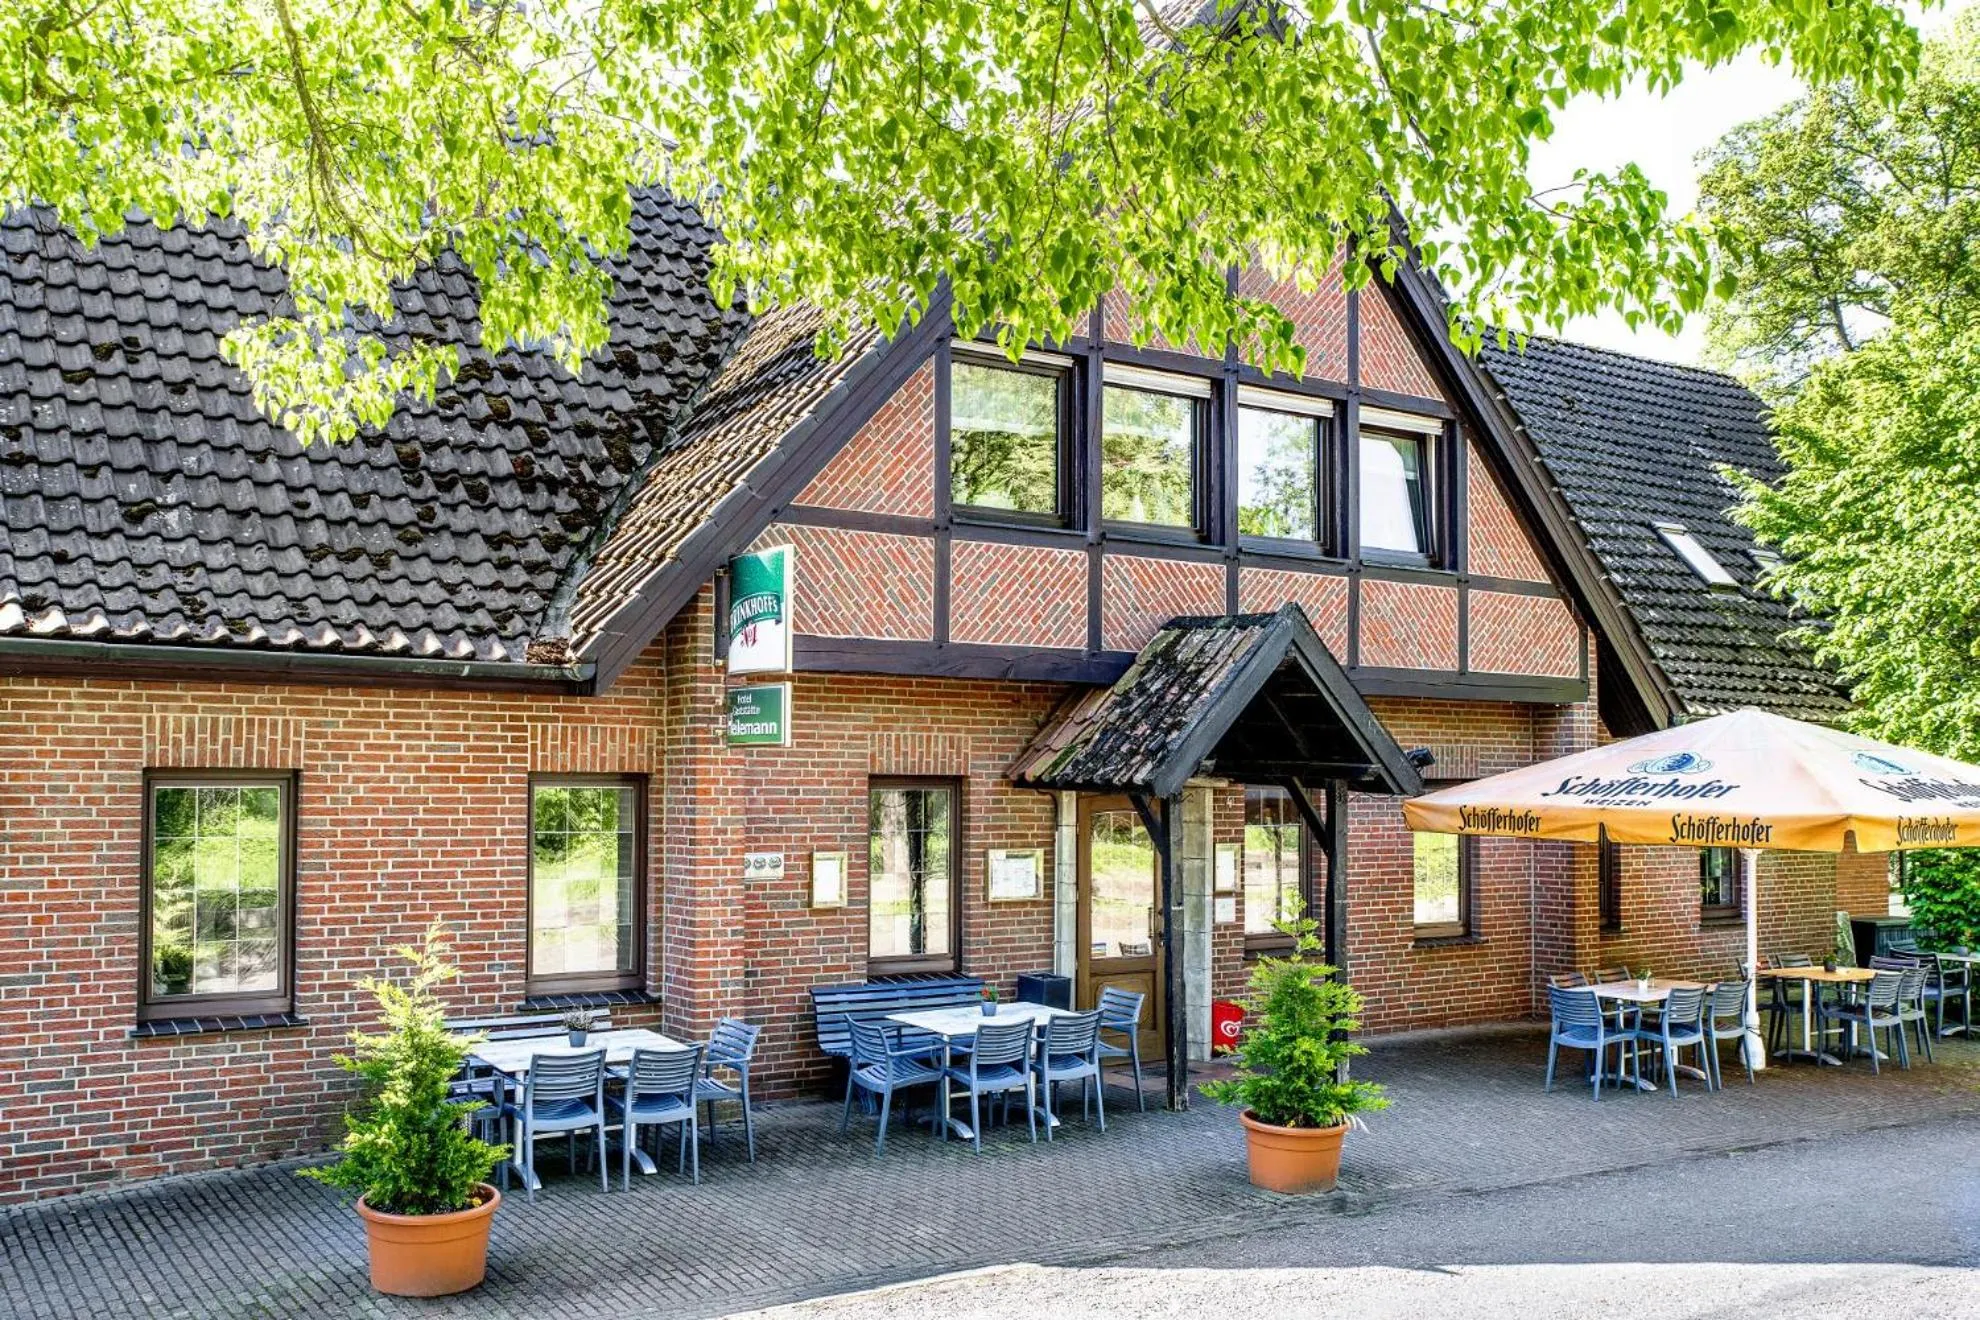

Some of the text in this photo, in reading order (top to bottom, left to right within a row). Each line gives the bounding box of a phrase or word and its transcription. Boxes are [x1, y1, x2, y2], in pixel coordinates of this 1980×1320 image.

[1541, 776, 1740, 800] Schöfferhofer
[1583, 798, 1653, 807] WEIZEN
[1458, 804, 1542, 834] Schöfferhofer
[1668, 812, 1774, 845] Schöfferhofer
[1896, 815, 1959, 847] Schöfferhofer
